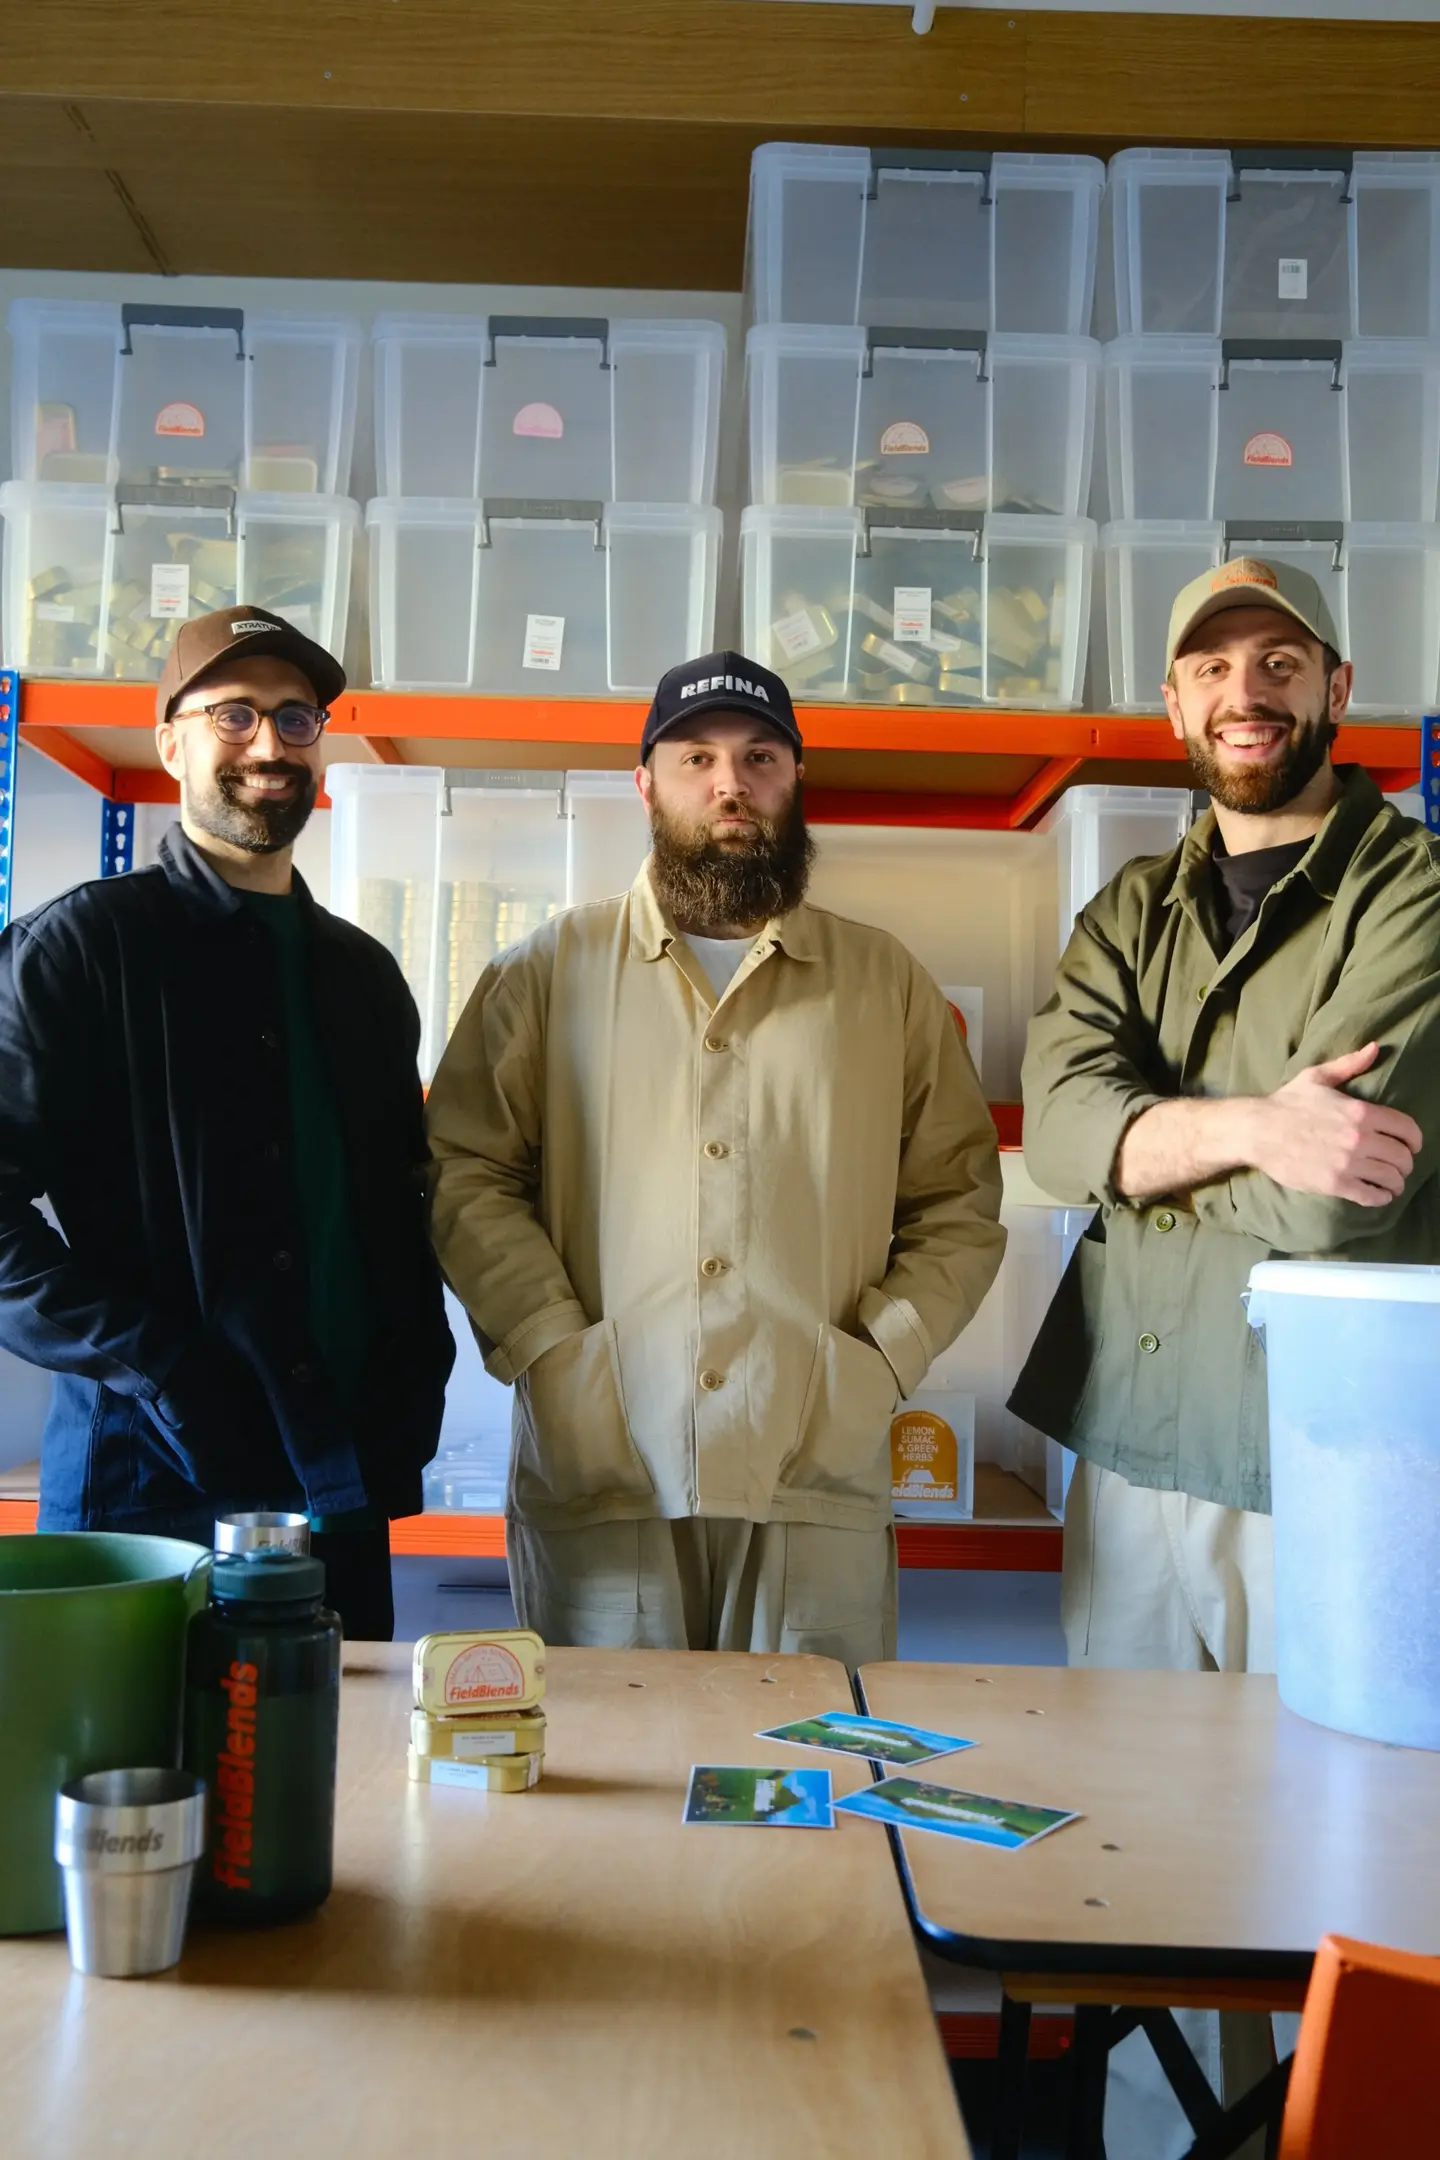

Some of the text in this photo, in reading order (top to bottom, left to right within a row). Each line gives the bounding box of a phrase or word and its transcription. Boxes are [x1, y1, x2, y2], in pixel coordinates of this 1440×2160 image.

[681, 675, 769, 702] REFINA
[901, 1427, 935, 1436] LEMON
[901, 1436, 935, 1444] SUMAC
[898, 1444, 939, 1453] & GREEN
[902, 1453, 933, 1461] HERBS
[891, 1483, 954, 1498] eldBlends
[450, 1683, 519, 1700] FieldBlends
[214, 1660, 258, 1888] FieldBlends
